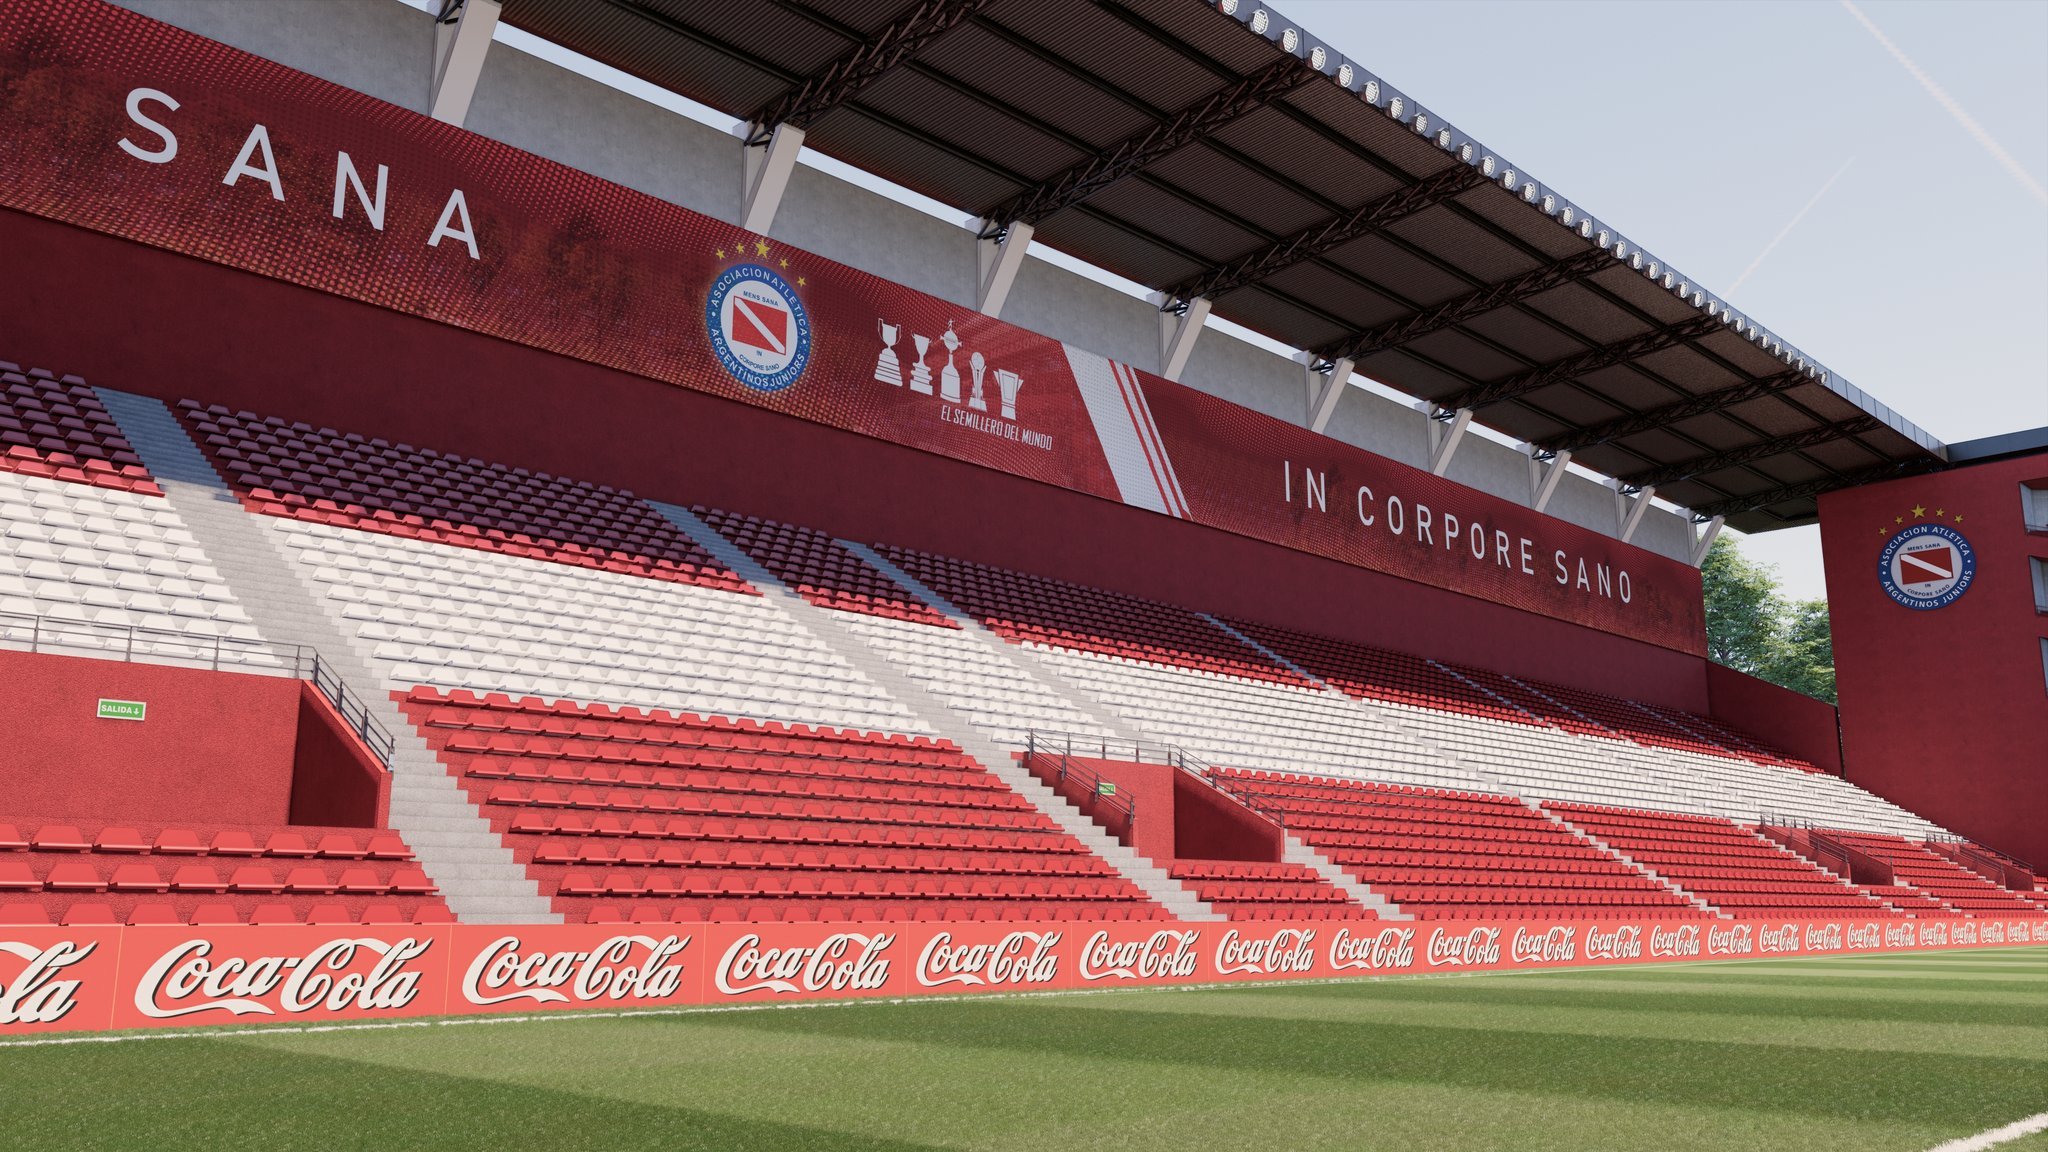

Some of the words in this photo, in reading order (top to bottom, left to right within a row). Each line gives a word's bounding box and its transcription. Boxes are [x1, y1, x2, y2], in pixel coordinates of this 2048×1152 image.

[117, 87, 481, 260] SANA
[711, 267, 770, 307] ASOCIACION
[771, 277, 808, 336] ATLETICA
[743, 290, 760, 301] MENS
[761, 296, 779, 307] SANA
[711, 328, 769, 387] ARGENTINOS
[770, 354, 805, 387] JUNIORS
[940, 404, 951, 422] EL
[953, 408, 1004, 437] SEMILLERO
[1004, 423, 1020, 442] DEL
[1021, 428, 1053, 451] MUNDO
[1284, 460, 1326, 513] IN
[1358, 486, 1534, 575] CORPORE
[1555, 550, 1631, 604] SANO
[1881, 526, 1928, 567] ASOCIACION
[1931, 526, 1970, 557] ATLETICA
[1883, 581, 1939, 608] ARGENTINOS
[1942, 570, 1972, 604] JUNIORS
[101, 704, 132, 714] SALIDA
[715, 933, 896, 995] Coca-Cola
[916, 931, 1062, 986] Coca-Cola
[1079, 930, 1201, 980] Coca-Cola
[1215, 929, 1316, 974] Coca-Cola
[1329, 928, 1416, 969] Coca-Cola
[1427, 927, 1502, 966] Coca-Cola
[1512, 926, 1576, 962] Coca-Cola
[134, 937, 434, 1018] Coca-Cola
[462, 935, 692, 1004] Coca-Cola
